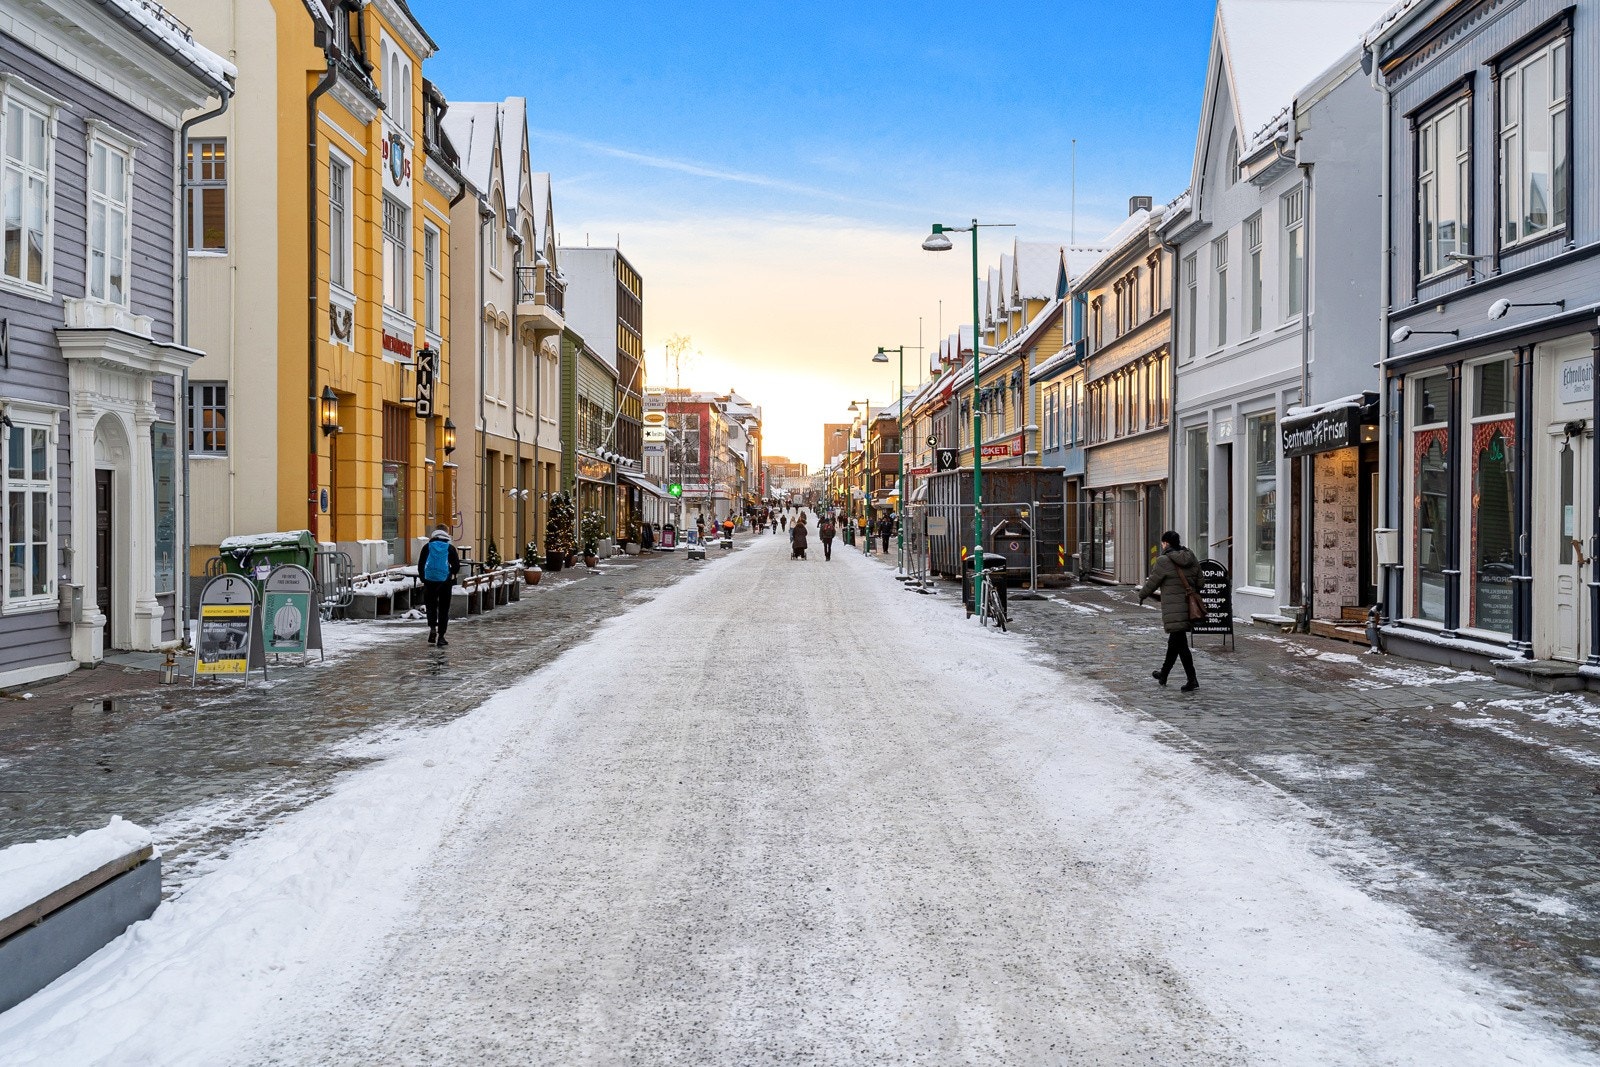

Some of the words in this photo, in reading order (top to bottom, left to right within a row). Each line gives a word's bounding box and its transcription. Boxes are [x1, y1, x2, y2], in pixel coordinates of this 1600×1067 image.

[382, 139, 389, 159] 19
[404, 158, 410, 179] 15
[417, 356, 431, 415] KINO
[1323, 418, 1348, 442] Frisør
